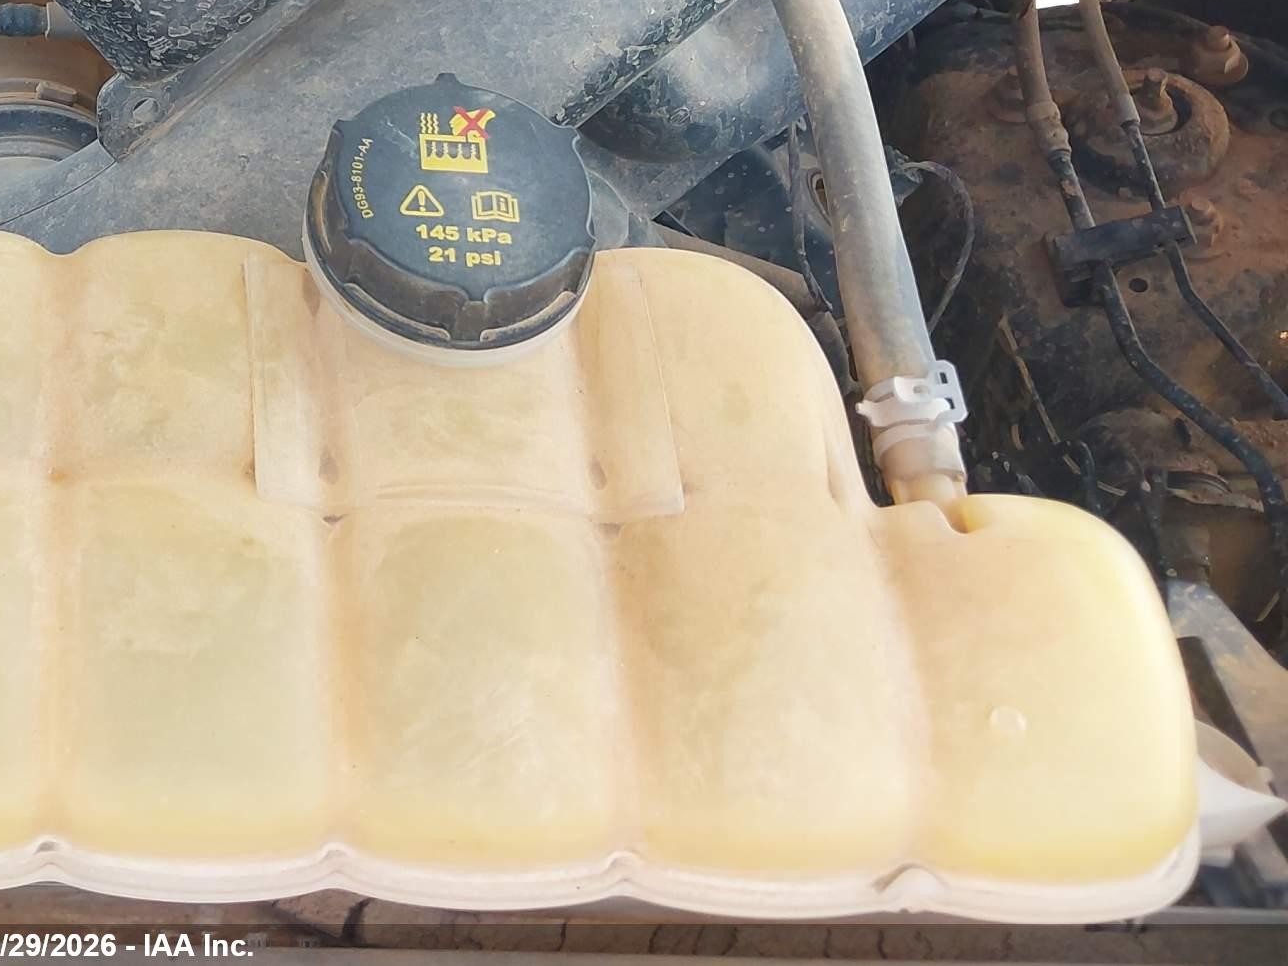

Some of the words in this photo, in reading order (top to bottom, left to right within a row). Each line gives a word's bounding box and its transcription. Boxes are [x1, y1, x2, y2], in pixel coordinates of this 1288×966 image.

[350, 137, 375, 219] DG93-8101-AA
[415, 223, 460, 241] 145
[466, 227, 512, 244] kPa
[428, 246, 456, 263] 21
[465, 250, 501, 268] psi
